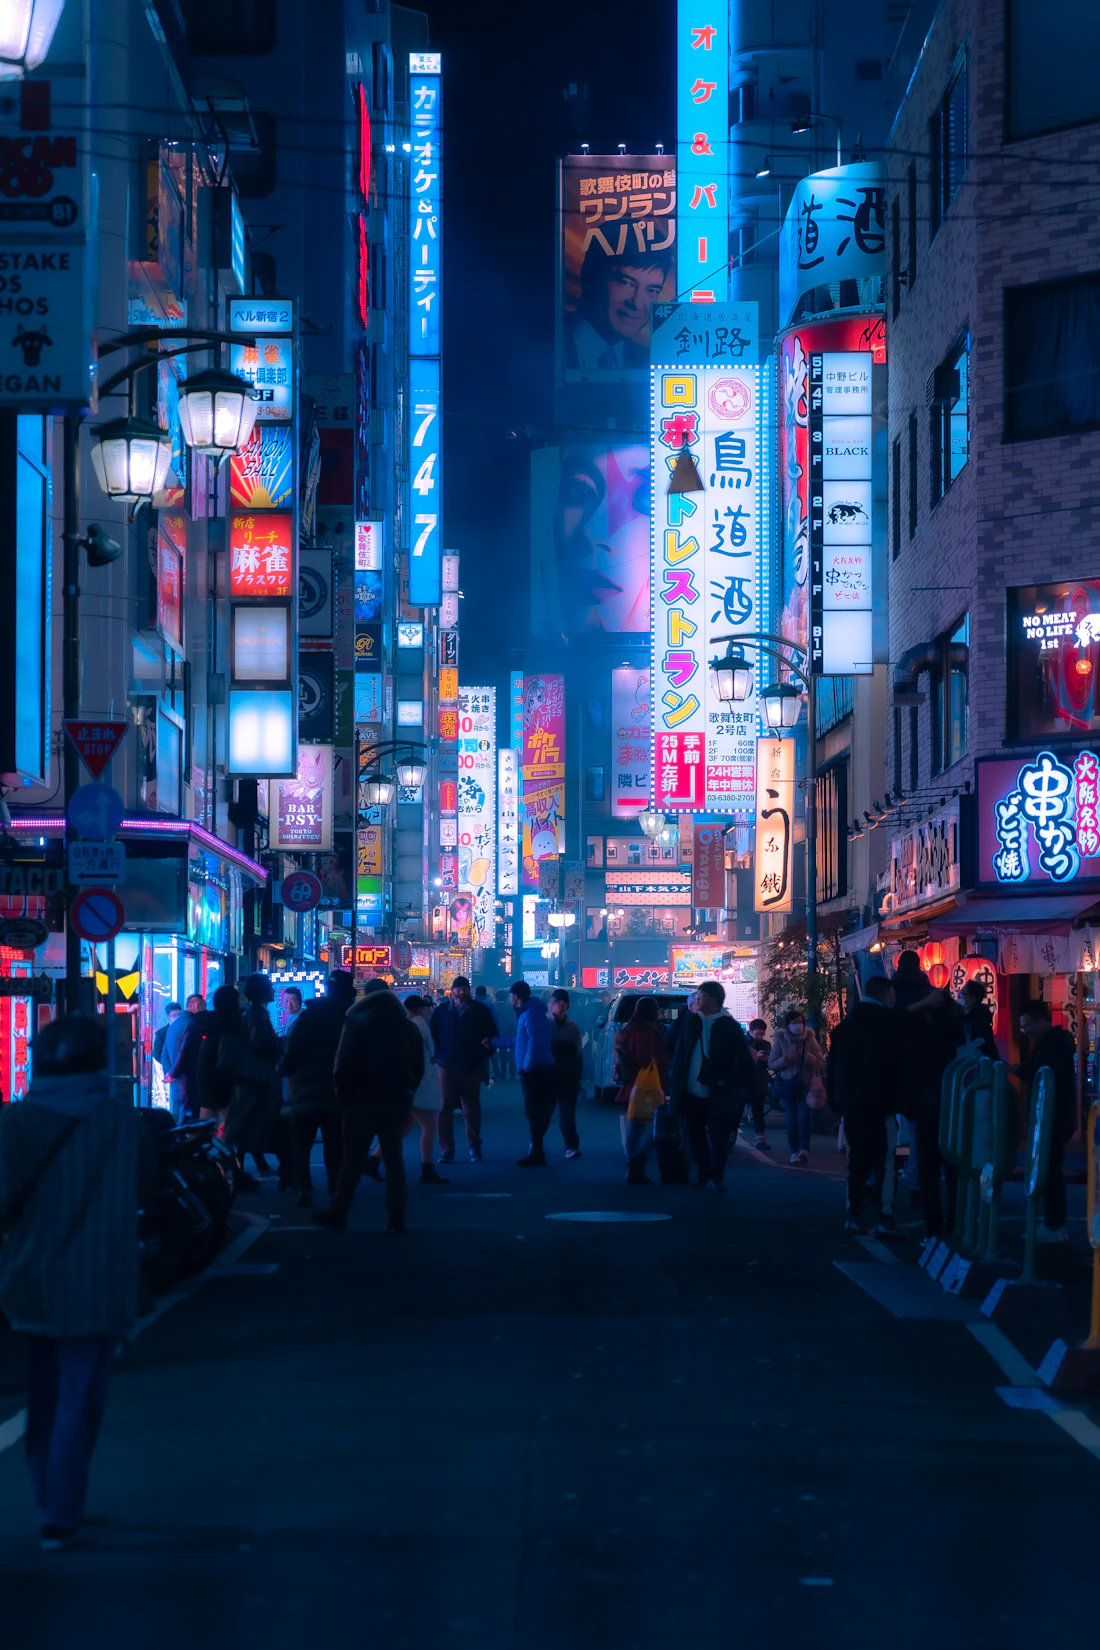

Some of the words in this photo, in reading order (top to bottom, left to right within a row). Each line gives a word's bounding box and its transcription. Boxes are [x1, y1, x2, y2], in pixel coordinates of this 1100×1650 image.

[53, 204, 72, 220] B1
[413, 85, 438, 338] カラオケ&パーティー
[579, 191, 676, 224] ワンラン
[580, 218, 676, 256] ヘパリ
[234, 310, 289, 322] ベル新宿2
[654, 306, 673, 318] 4F
[677, 312, 753, 322] 北海道居酒屋
[673, 326, 751, 358] 釧路
[243, 344, 280, 364] 麻雀
[812, 356, 822, 379] 5F
[825, 371, 869, 382] 中野ビル
[0, 375, 61, 393] GAN
[825, 385, 869, 394] 管理事務所
[812, 388, 822, 410] 4F
[812, 431, 822, 465] 3F
[825, 447, 869, 456] BLACK
[240, 460, 280, 478] BALL
[412, 403, 438, 557] 747
[812, 496, 822, 531] 2F
[244, 531, 279, 544] リーチ
[231, 544, 290, 574] 麻雀
[709, 431, 753, 698] 鳥道酒
[813, 561, 822, 596] 1F
[276, 586, 289, 595] 3F
[1023, 616, 1039, 627] NO
[1042, 612, 1077, 626] MEAT
[1026, 627, 1045, 639] NO
[1046, 624, 1073, 637] LIFE
[447, 632, 456, 659] ダーツ
[812, 626, 822, 661] B1F
[1041, 638, 1059, 650] 1st
[440, 712, 458, 737] 麻雀
[709, 712, 754, 724] 歌舞伎町
[77, 727, 116, 741] 止まれ
[527, 727, 557, 750] ポケ
[716, 725, 747, 736] 2号店
[83, 743, 111, 755] STOP
[618, 744, 650, 766] まね
[683, 735, 700, 764] 手前
[661, 735, 679, 793] 25M左折
[707, 766, 754, 778] 24H営業
[618, 773, 650, 789] 隣ビ
[707, 779, 754, 791] 年中無休
[288, 804, 315, 813] BAR
[524, 795, 561, 818] 高収入
[1078, 756, 1098, 853] 大阪名物
[284, 815, 318, 826] PSY
[1023, 758, 1069, 876] 串かつ
[996, 795, 1022, 876] どて焼
[73, 847, 121, 858] 自転車を除く
[73, 858, 120, 870] 一方通行
[696, 829, 713, 902] Orange
[714, 855, 722, 872] Bar
[290, 883, 312, 902] 69
